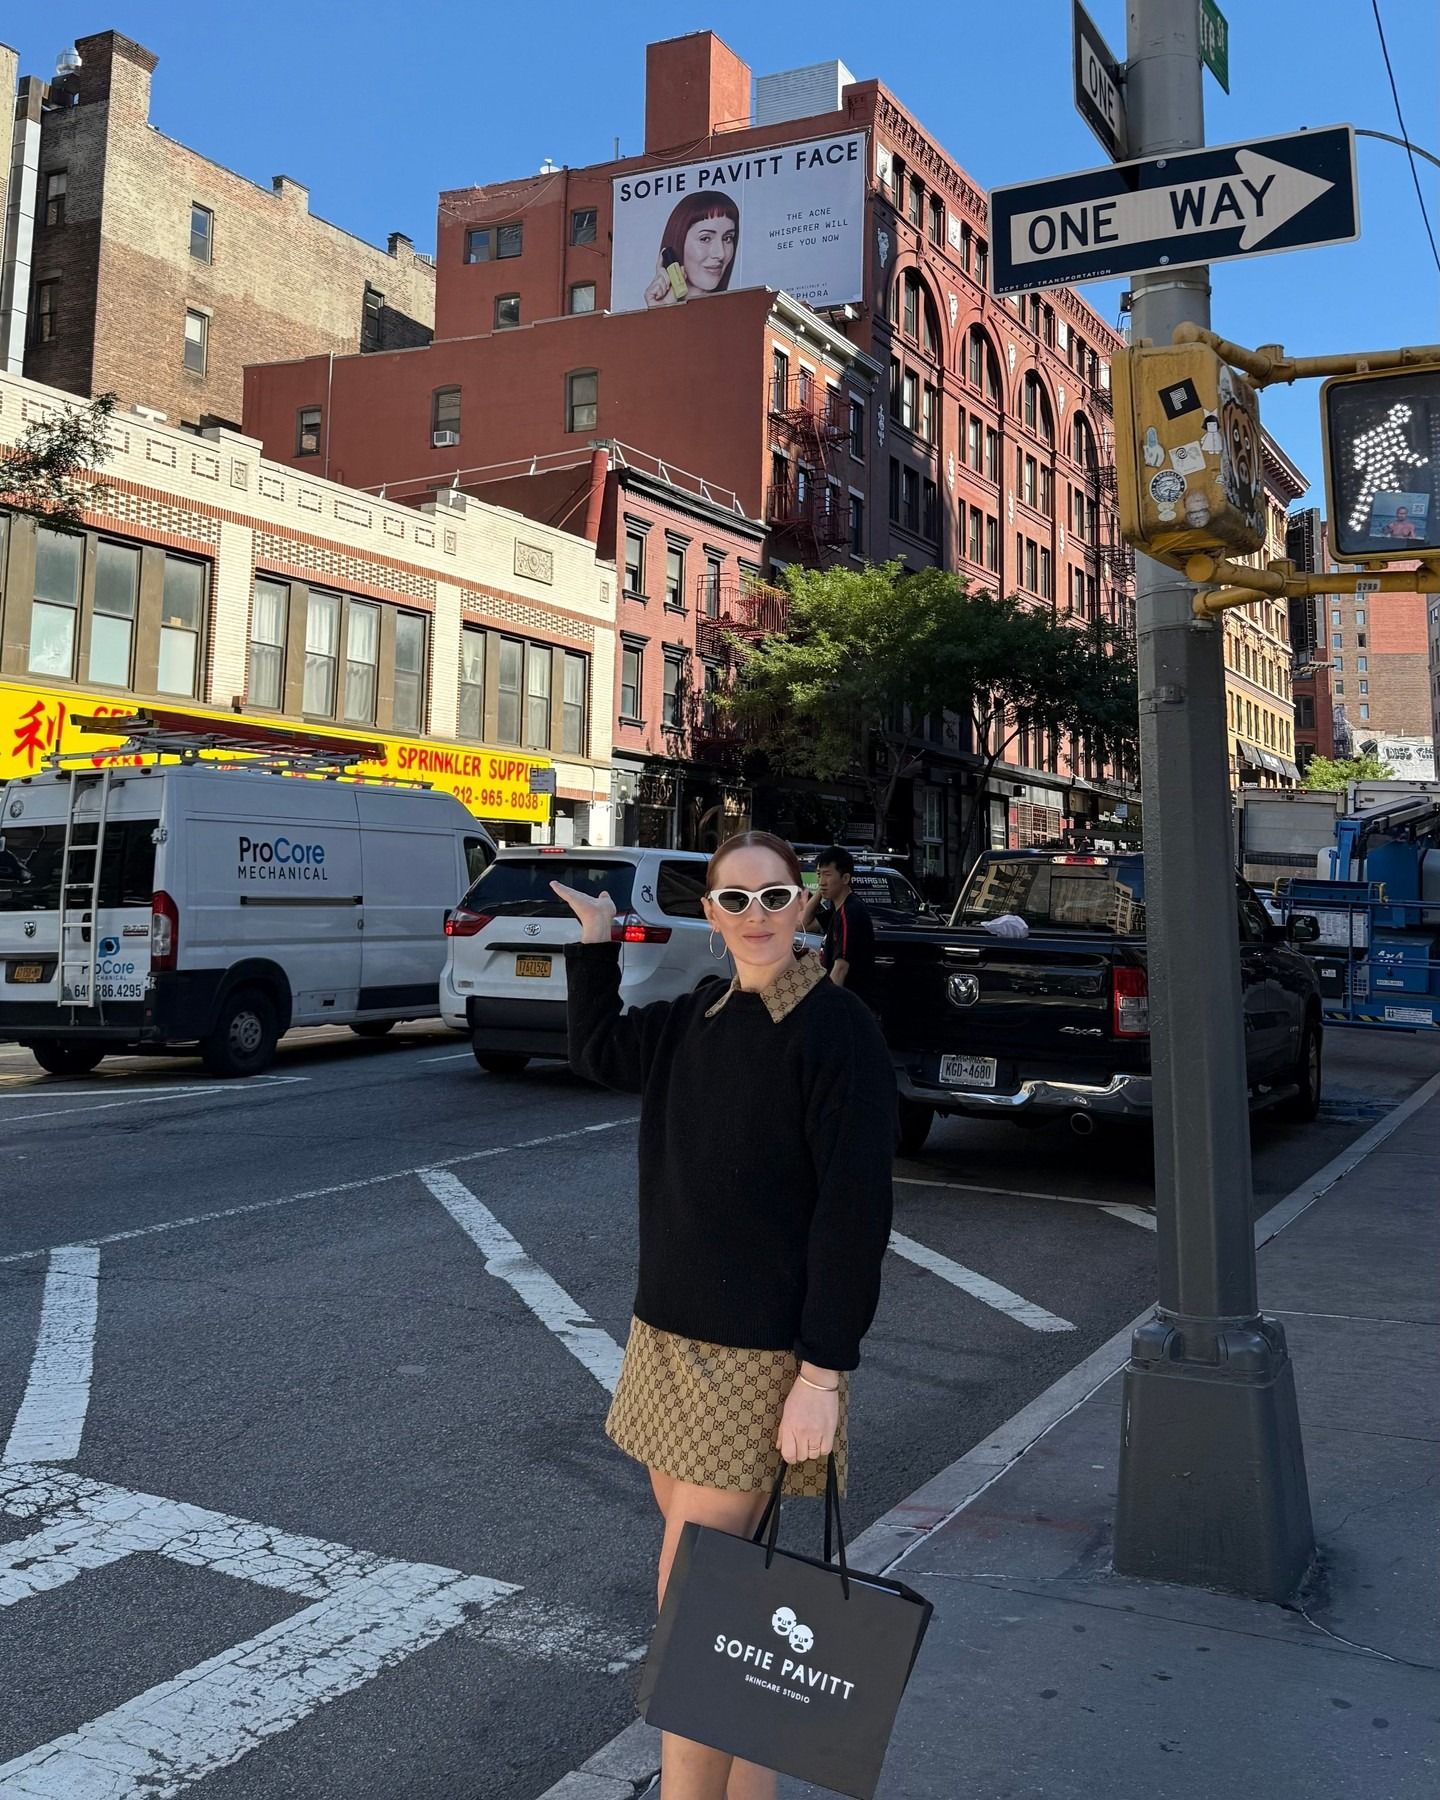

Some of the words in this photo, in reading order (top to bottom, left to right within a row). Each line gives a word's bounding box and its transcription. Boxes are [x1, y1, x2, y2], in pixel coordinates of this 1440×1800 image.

[1200, 8, 1215, 61] tre
[1089, 55, 1115, 129] ONE
[620, 173, 686, 202] SOFIE
[698, 155, 783, 188] PAVITT
[795, 141, 858, 171] FACE
[787, 212, 803, 221] THE
[809, 207, 831, 217] ACNE
[1028, 202, 1119, 254] ONE
[1169, 174, 1276, 230] WAY
[769, 223, 820, 238] WHISPERER
[825, 218, 848, 229] WILL
[777, 240, 794, 250] SEE
[799, 237, 817, 247] YOU
[822, 234, 840, 243] NOW
[999, 285, 1019, 293] DEPT
[1038, 269, 1111, 287] TRANSPORTATION
[790, 289, 829, 300] EPHORA
[12, 700, 66, 769] 利
[397, 748, 481, 777] SPRINKLER
[489, 758, 539, 783] SUPPL
[239, 836, 325, 864] ProCore
[238, 866, 328, 881] MECHANICAL
[81, 960, 135, 974] PoCore
[74, 984, 142, 998] 64286.4295
[1058, 1026, 1104, 1037] 4x4
[714, 1634, 774, 1671] SOFIE
[780, 1658, 855, 1700] PAVITT
[745, 1674, 781, 1693] SKINCARE
[782, 1689, 810, 1704] STUDIO
